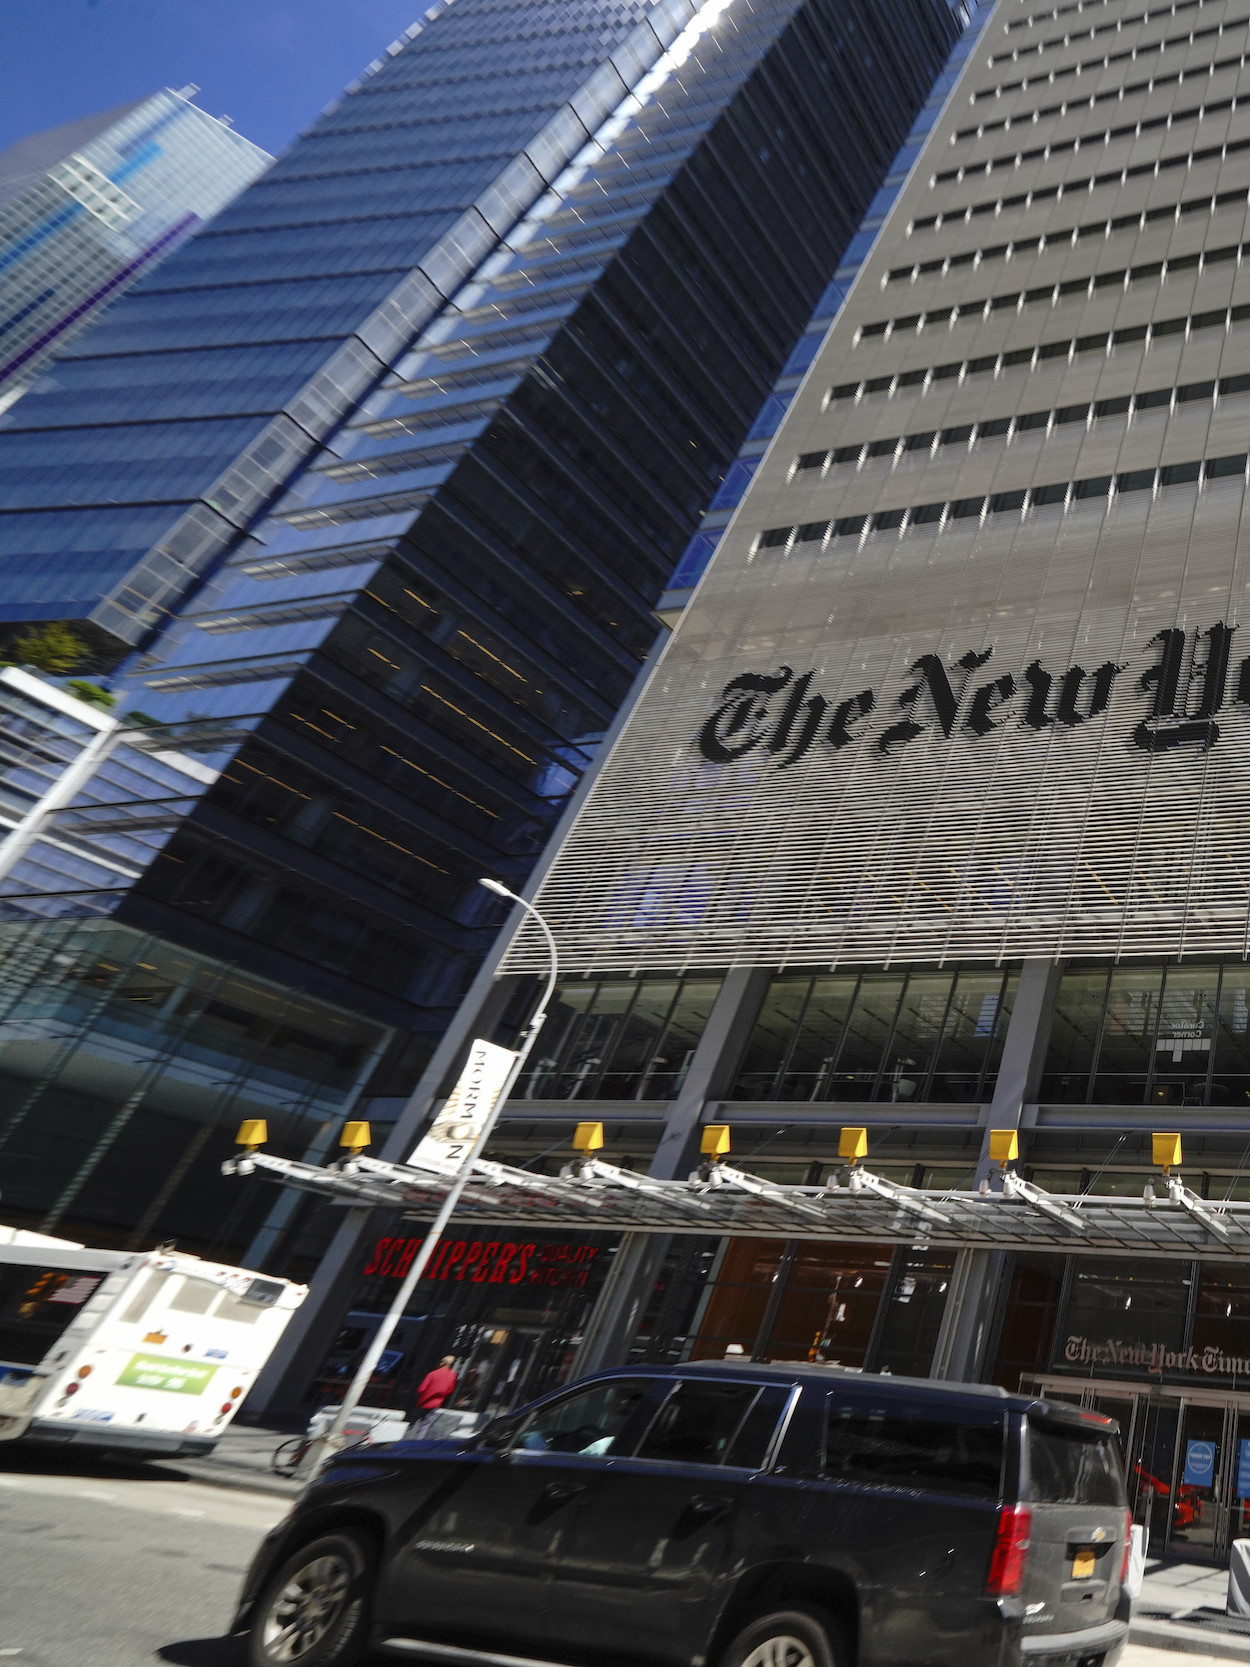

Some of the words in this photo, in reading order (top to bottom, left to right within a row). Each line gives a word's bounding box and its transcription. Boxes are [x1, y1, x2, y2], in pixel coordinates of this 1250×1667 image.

[699, 664, 874, 769] The
[876, 644, 1131, 757] New
[363, 1236, 537, 1285] SCHIPPER'S
[1064, 1335, 1102, 1362] The
[1101, 1338, 1147, 1365] New
[1147, 1342, 1200, 1375] York
